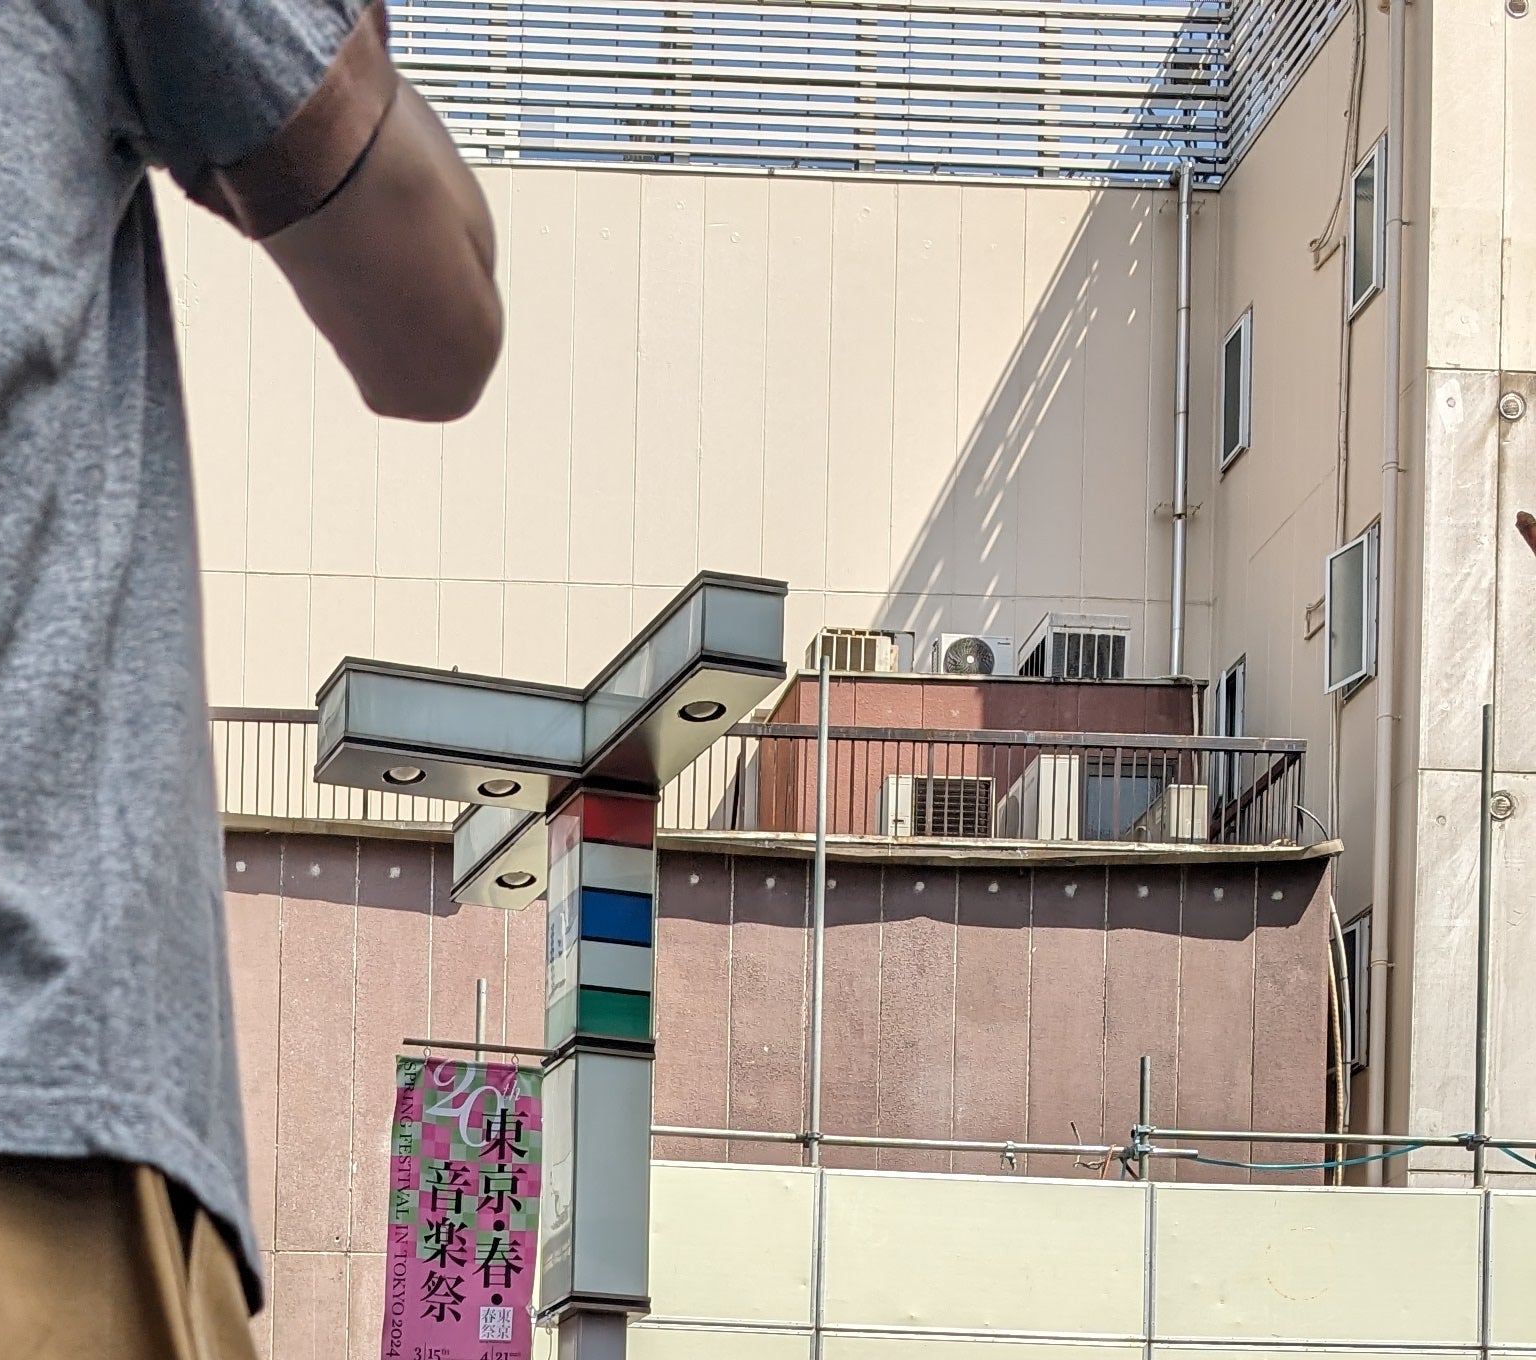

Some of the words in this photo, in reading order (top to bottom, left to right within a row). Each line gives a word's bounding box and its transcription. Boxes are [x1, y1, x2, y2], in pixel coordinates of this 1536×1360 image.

[399, 1061, 417, 1129] SPRING
[395, 1133, 414, 1220] FESTIVAL
[394, 1225, 409, 1244] IN
[419, 1161, 472, 1322] 音楽祭
[391, 1251, 408, 1316] TOKYO
[386, 1319, 403, 1358] 2024
